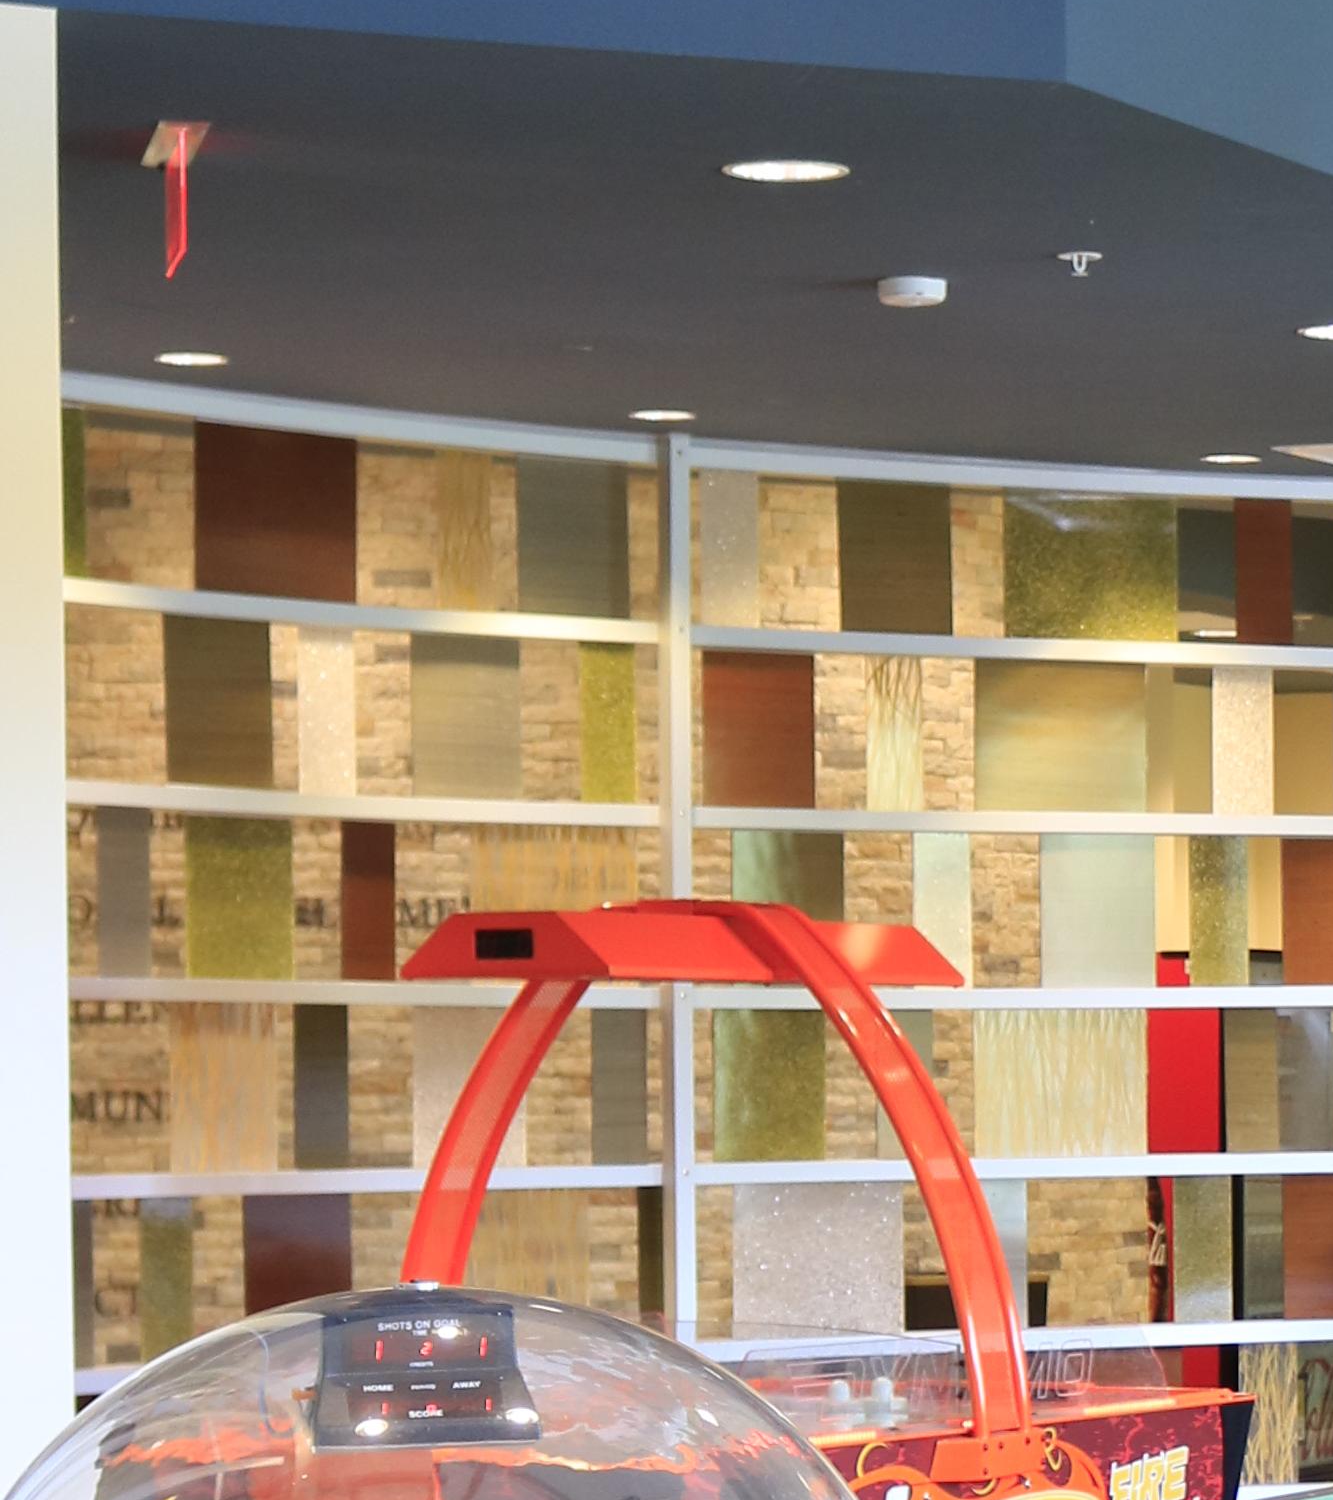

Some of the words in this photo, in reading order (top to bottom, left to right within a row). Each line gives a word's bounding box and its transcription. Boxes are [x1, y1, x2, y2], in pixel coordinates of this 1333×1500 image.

[377, 1322, 412, 1332] SHOTS
[415, 1320, 431, 1329] ON
[362, 1384, 394, 1392] HOME
[452, 1381, 481, 1389] AWAY
